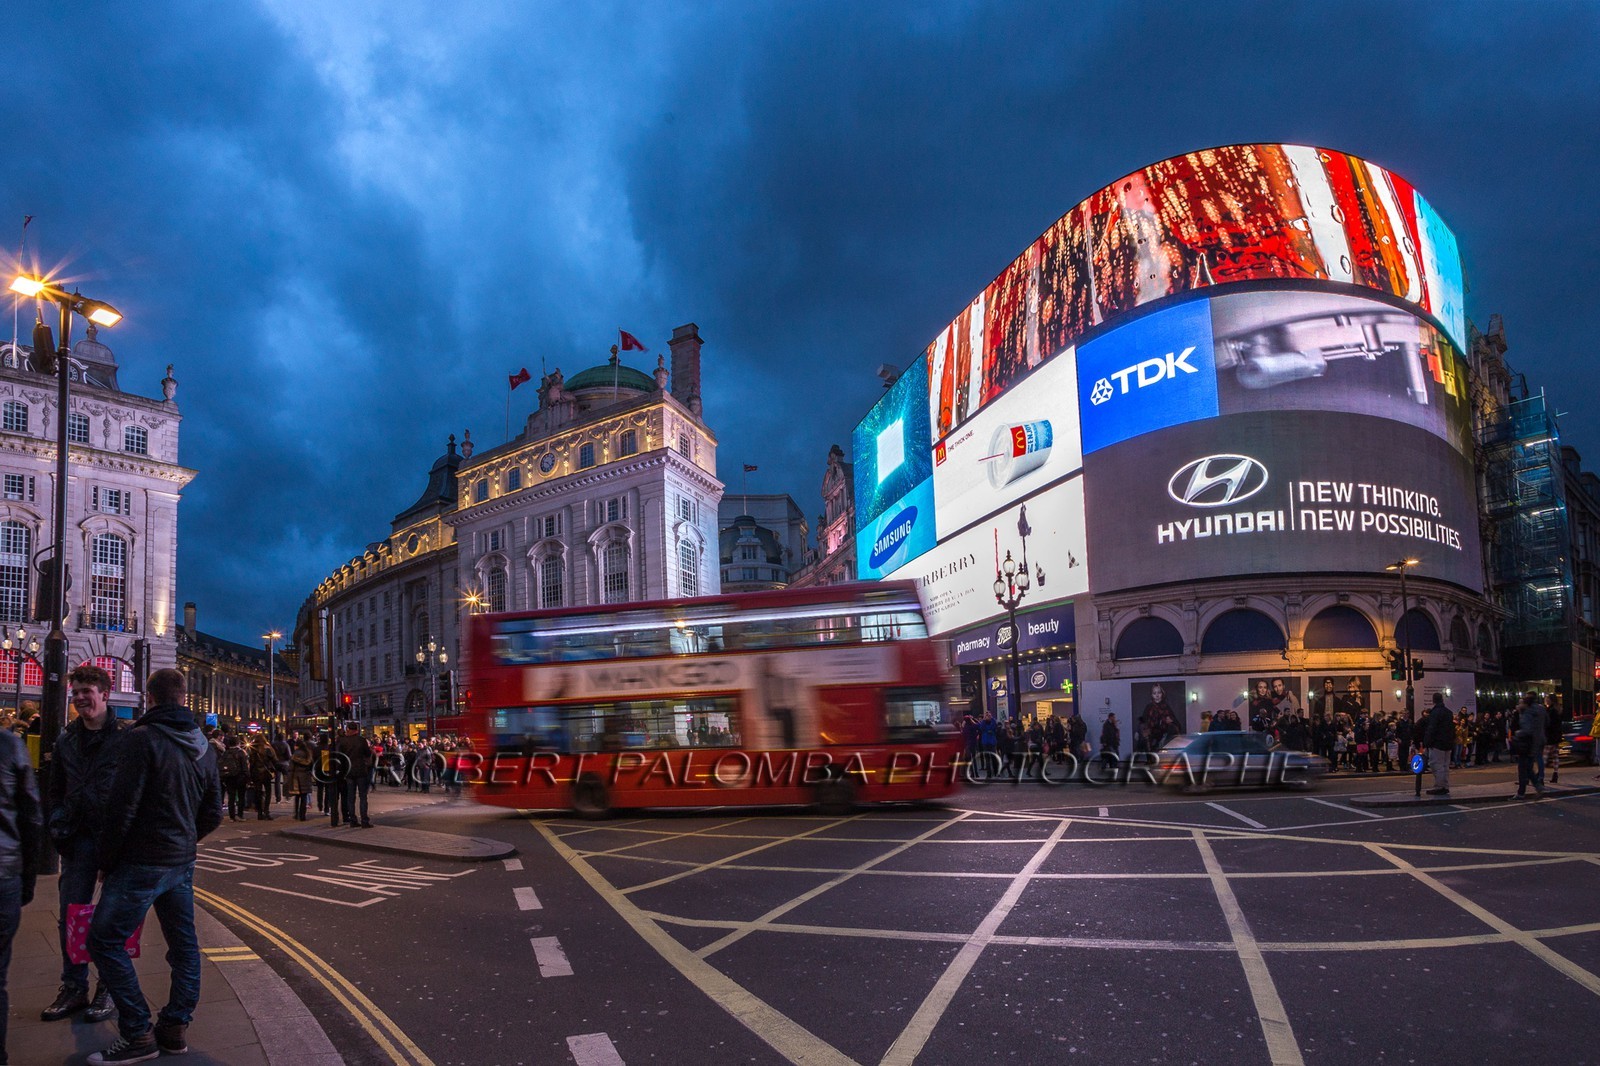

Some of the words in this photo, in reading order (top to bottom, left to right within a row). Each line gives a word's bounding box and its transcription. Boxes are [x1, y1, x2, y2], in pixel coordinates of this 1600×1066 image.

[1111, 346, 1199, 395] TDK
[1299, 481, 1353, 503] NEW
[1358, 483, 1442, 518] THINKING.
[873, 520, 911, 556] SAMSUNG
[1157, 510, 1285, 544] HYUNDAI
[1300, 509, 1355, 531] NEW
[1360, 510, 1462, 550] POSSIBILITIES.
[1028, 618, 1060, 636] beauty
[957, 636, 991, 655] pharmacy
[239, 859, 478, 908] LANE
